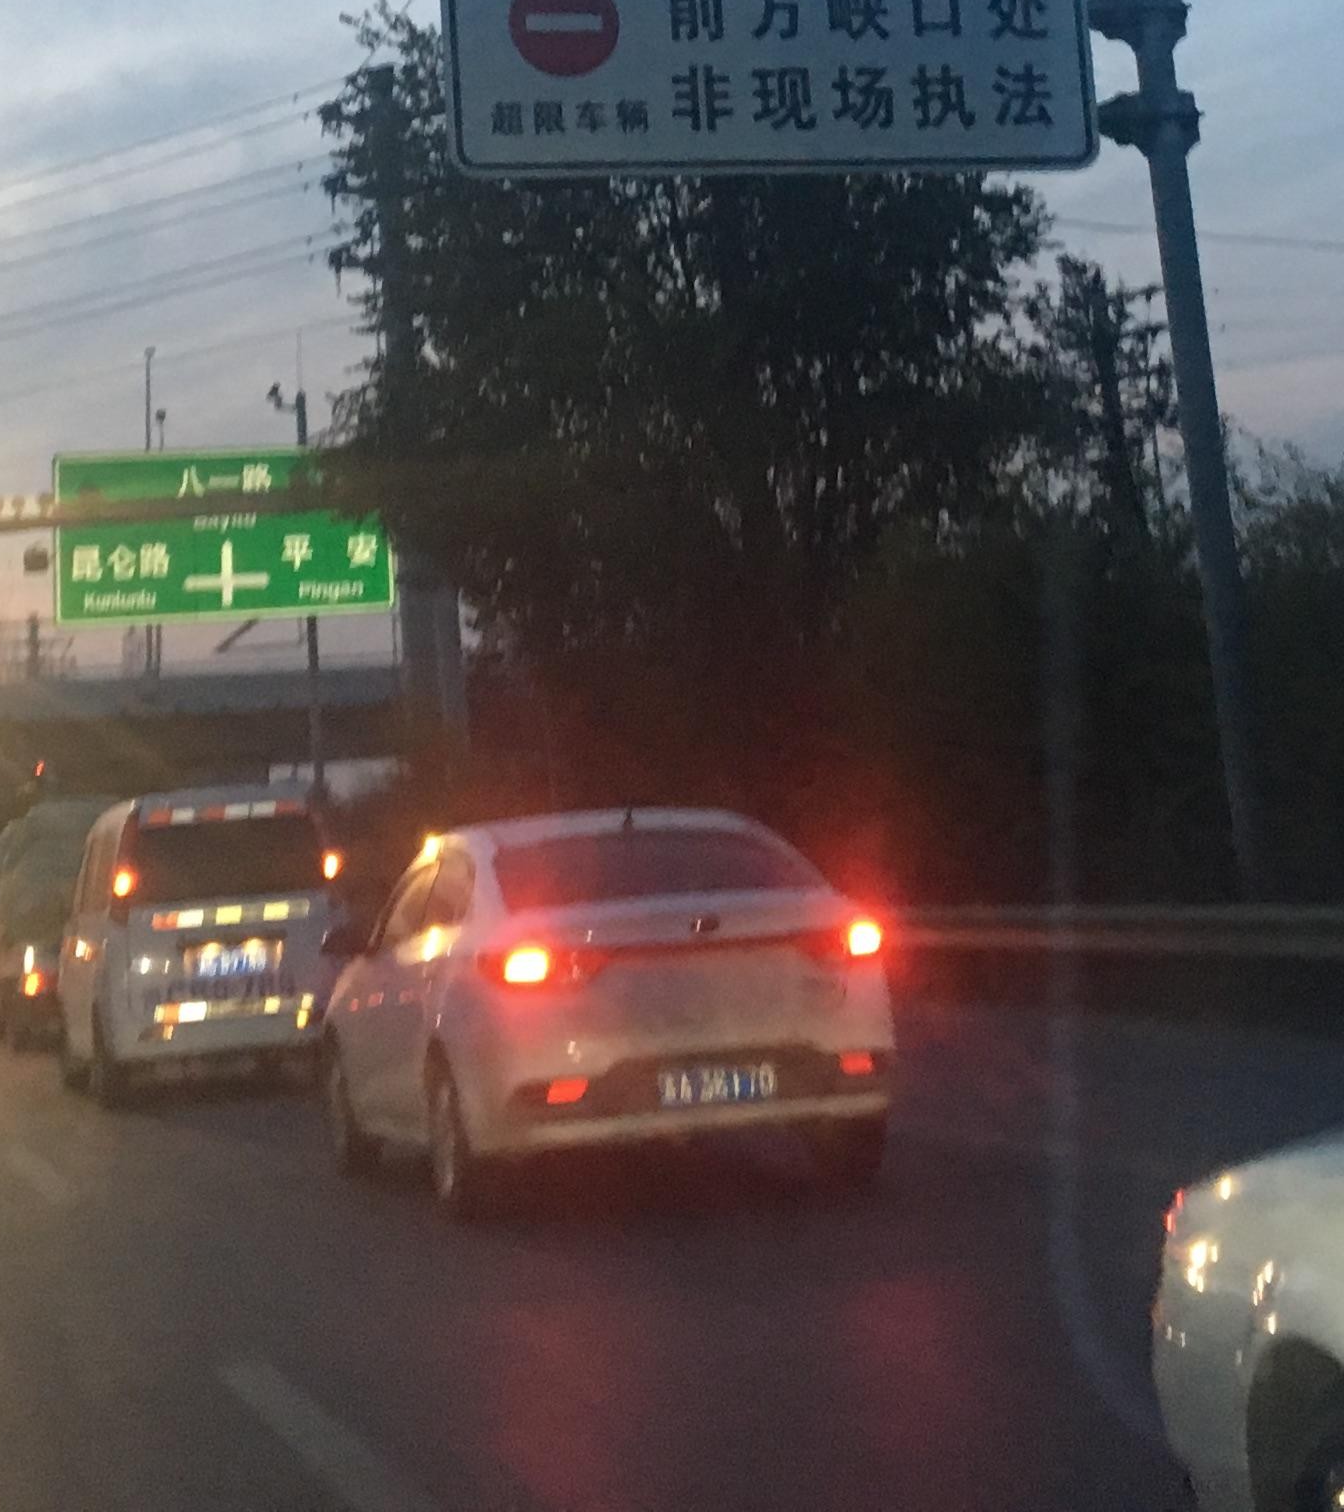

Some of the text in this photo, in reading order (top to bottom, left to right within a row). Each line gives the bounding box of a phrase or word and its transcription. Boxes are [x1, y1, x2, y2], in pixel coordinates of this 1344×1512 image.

[490, 98, 650, 137] 超限车辆
[671, 63, 1056, 133] 非现场执法
